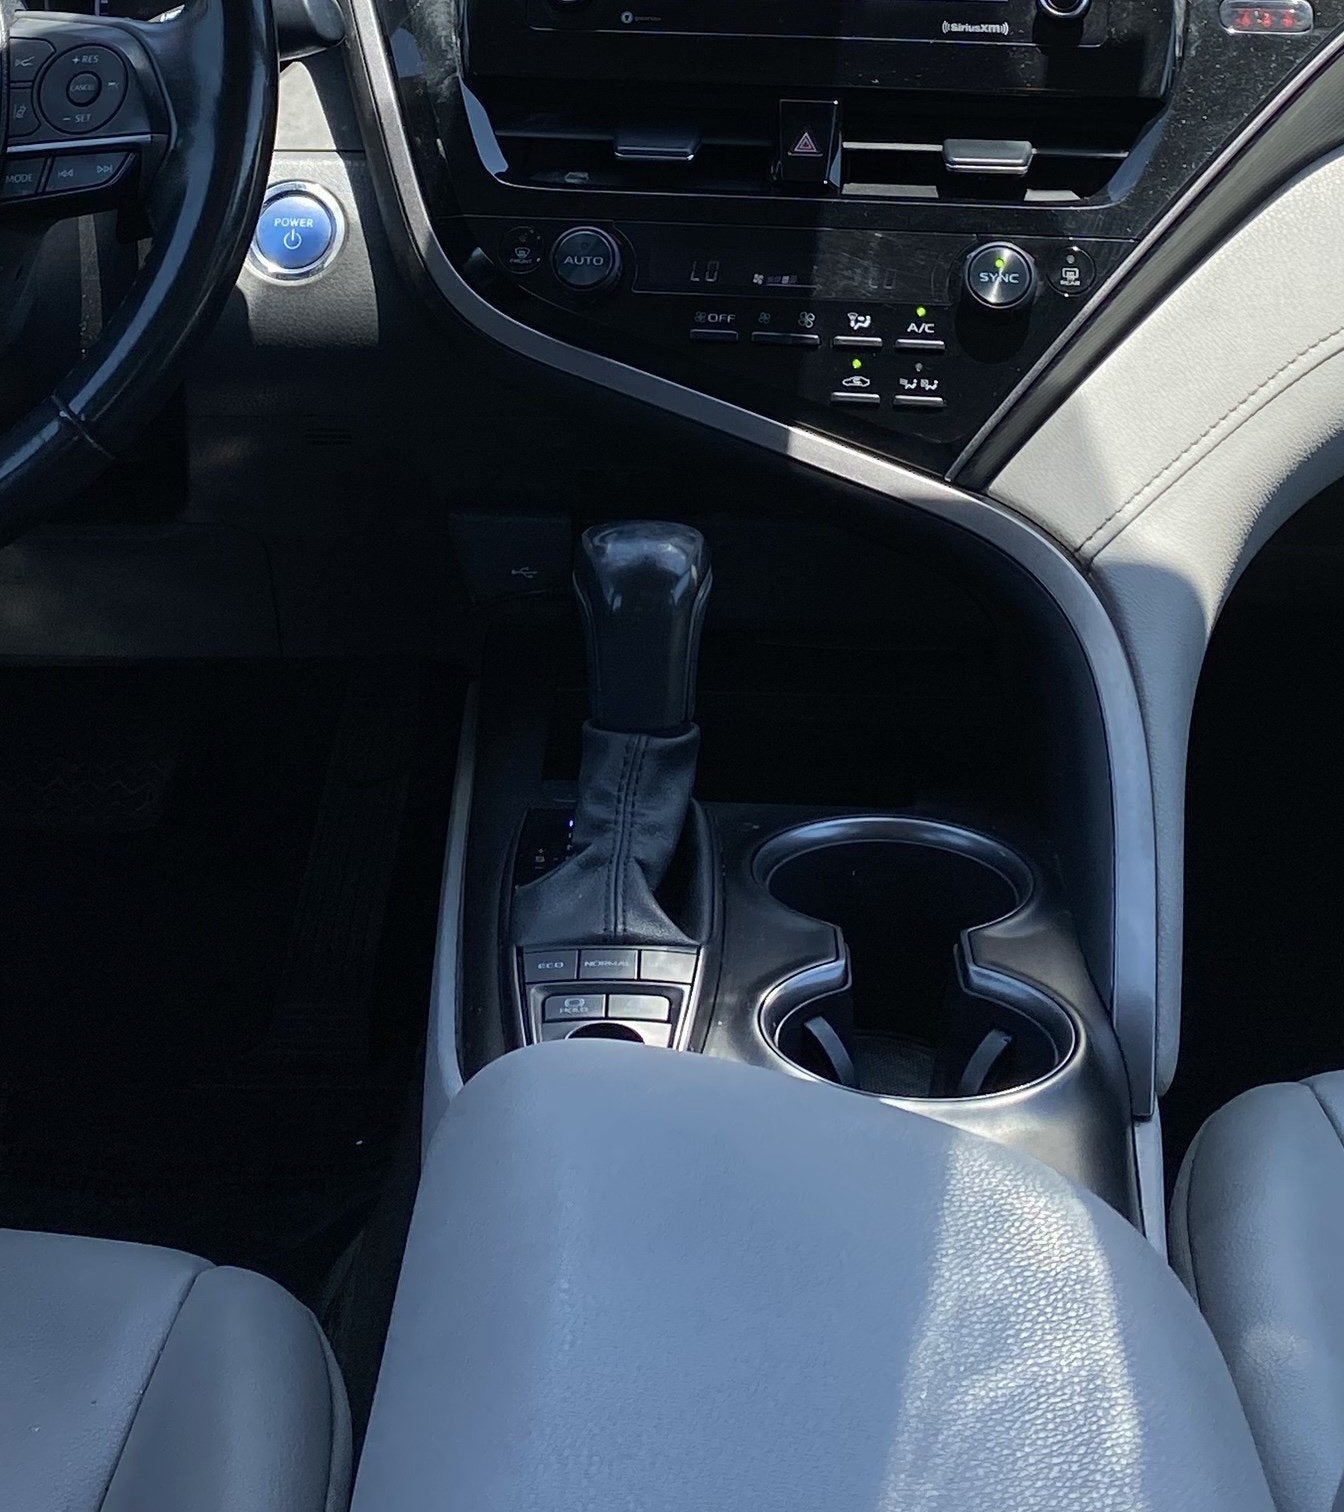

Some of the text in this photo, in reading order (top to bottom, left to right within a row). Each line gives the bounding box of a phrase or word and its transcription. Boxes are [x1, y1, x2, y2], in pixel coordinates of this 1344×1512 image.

[7, 173, 33, 184] MODE
[274, 217, 314, 228] POWER
[563, 255, 604, 266] AUTO
[690, 260, 720, 283] LO
[979, 272, 1019, 284] SYNC
[708, 313, 736, 323] OFF
[907, 323, 935, 334] A/C
[537, 960, 564, 970] ECO
